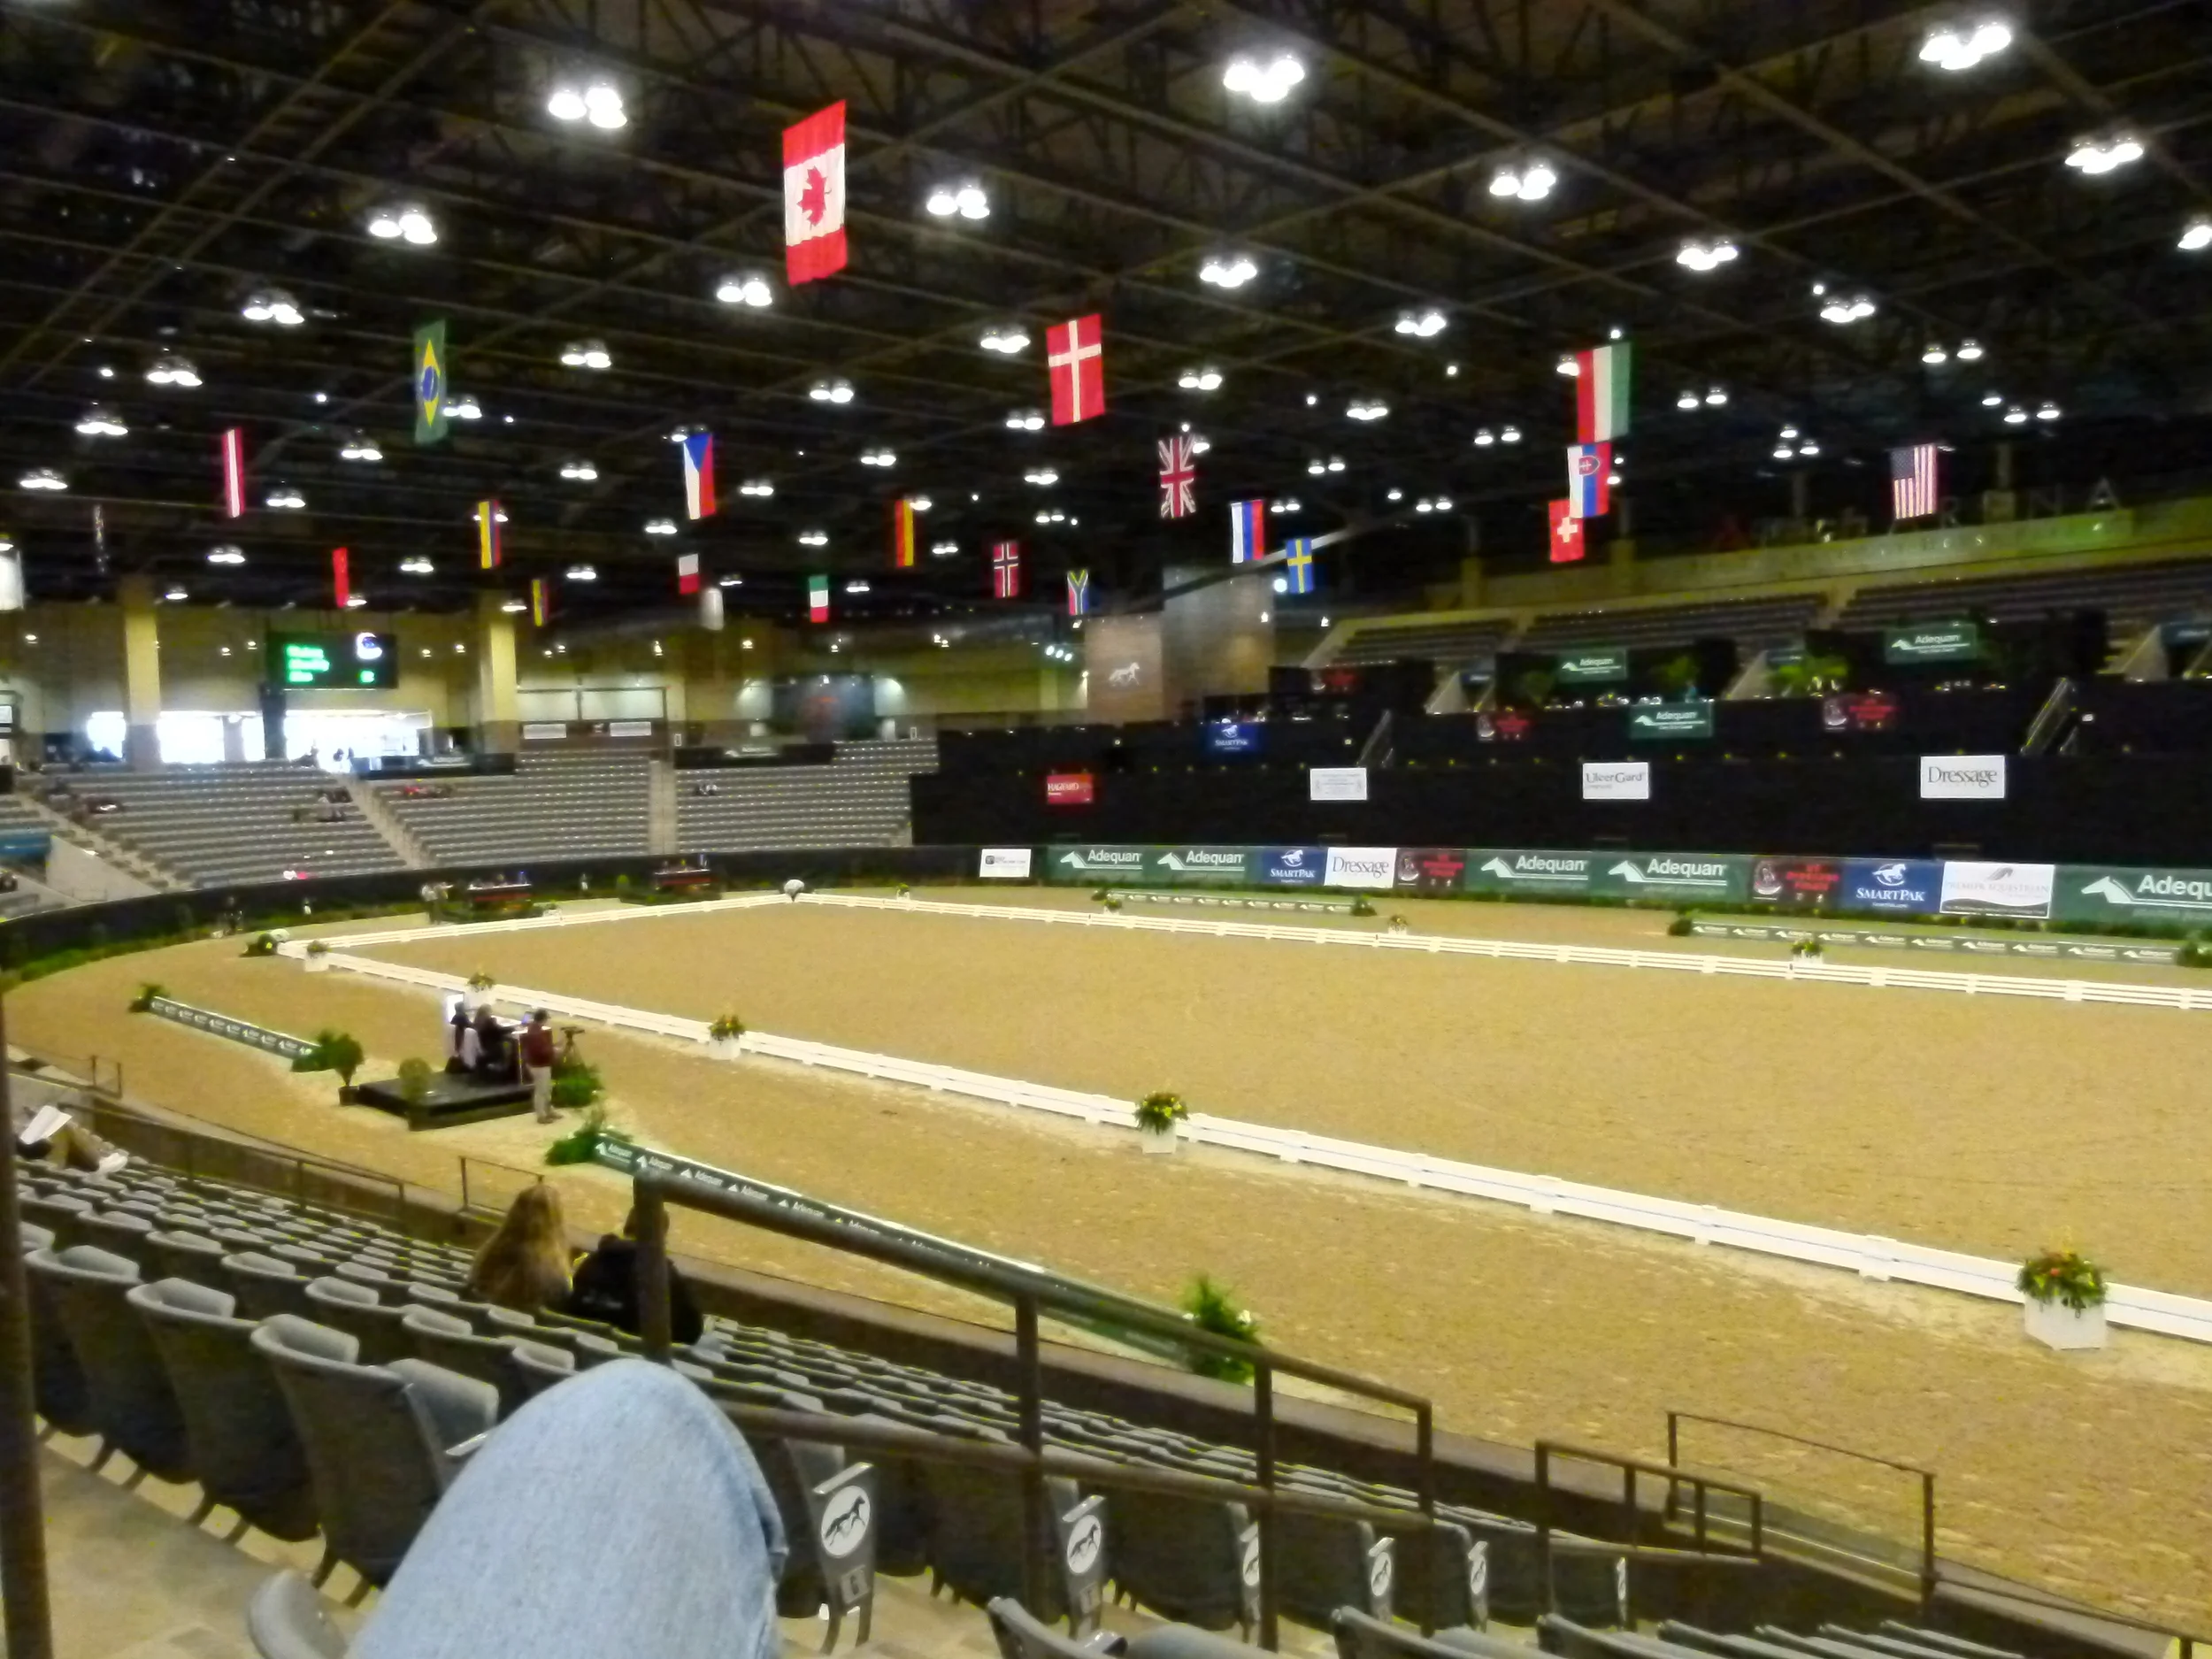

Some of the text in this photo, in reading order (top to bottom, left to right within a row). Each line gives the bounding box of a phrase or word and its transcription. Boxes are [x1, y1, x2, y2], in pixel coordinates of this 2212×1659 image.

[1928, 766, 1997, 788] Dressage
[1087, 849, 1141, 864] Adequan
[1186, 850, 1242, 864] Adequan
[1515, 855, 1586, 872] Adequan
[1333, 856, 1389, 879] Dressage
[1647, 858, 1724, 878] Adequan
